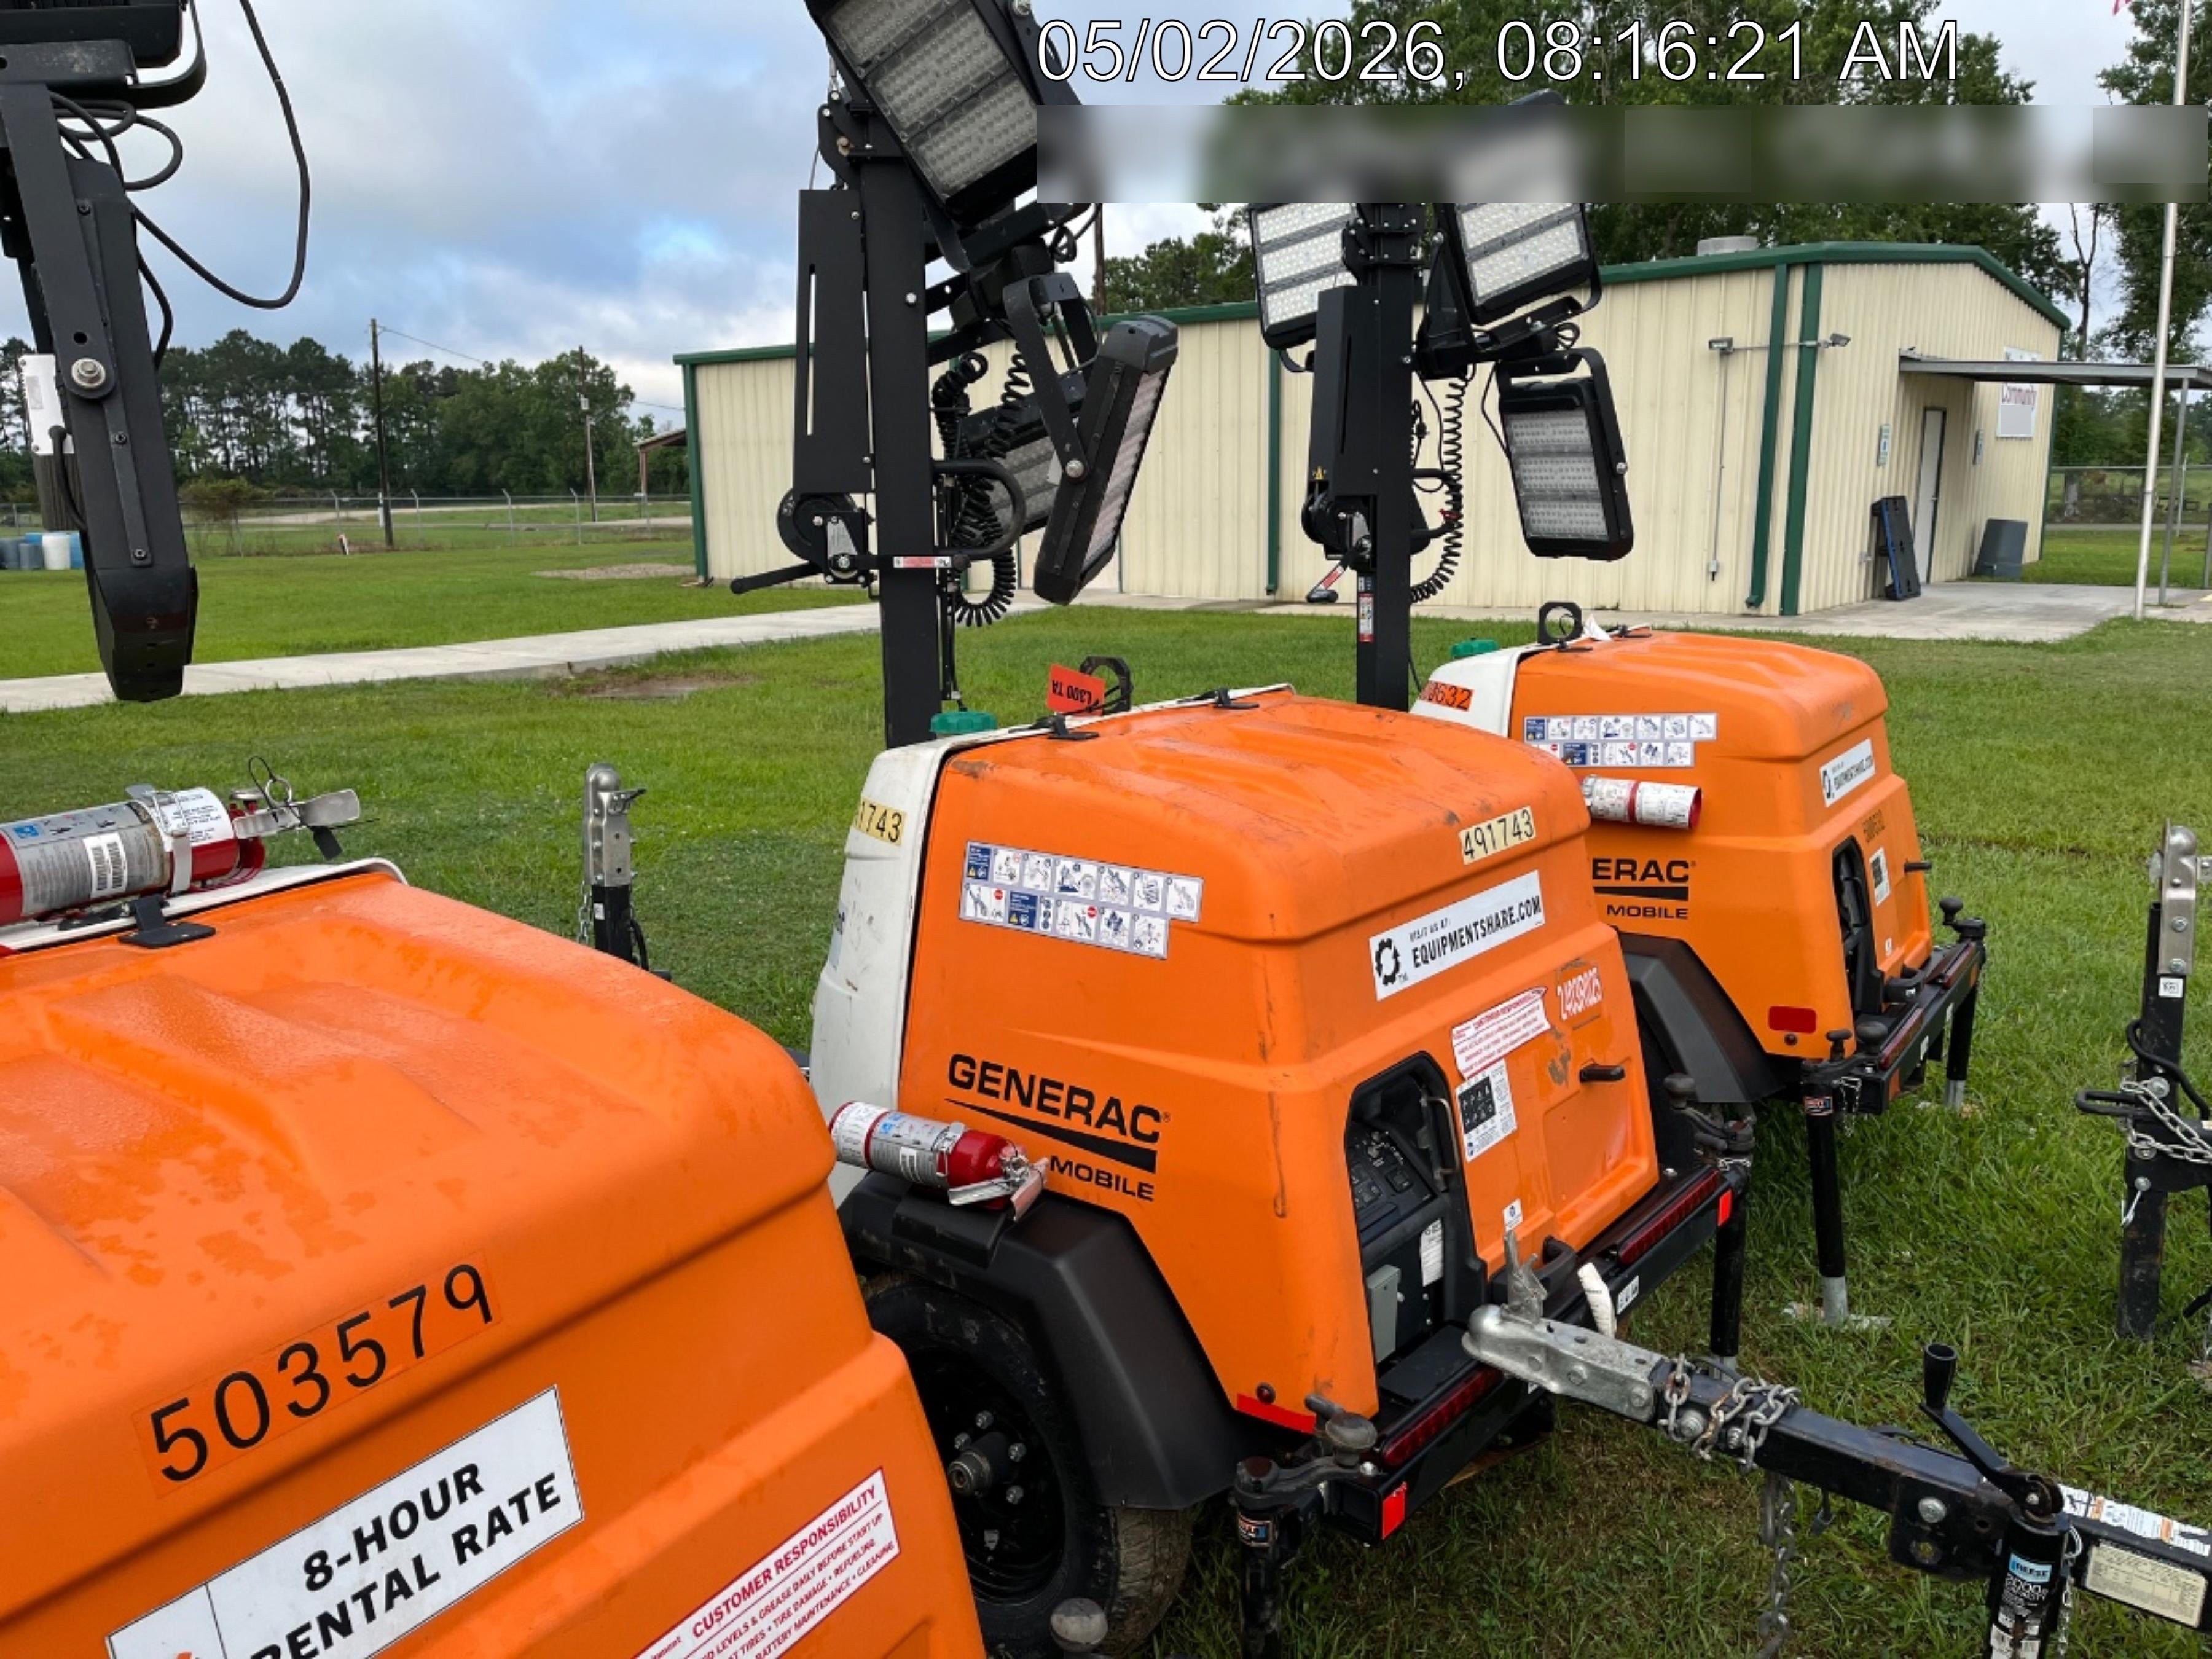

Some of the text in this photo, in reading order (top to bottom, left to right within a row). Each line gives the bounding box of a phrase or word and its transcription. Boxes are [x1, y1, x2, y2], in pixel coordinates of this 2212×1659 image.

[855, 801, 902, 842] 1743
[1463, 809, 1534, 860] 491743
[1593, 858, 1689, 884] ERAC
[1607, 904, 1689, 920] MOBILE
[1411, 895, 1542, 968] EQUIPMENTSHARE.COM
[948, 1053, 1161, 1144] GENERAC
[1049, 1155, 1155, 1202] MOBILE
[150, 1263, 493, 1483] 503579
[303, 1463, 485, 1592] 8-HOUR
[450, 1472, 562, 1565] RATE
[692, 1484, 876, 1638] CUSTOMER RESPONSIBILITY
[716, 1512, 884, 1654] LEVELS & GREASE DAILY BEFORE START UP
[740, 1629, 766, 1655] TIRES
[772, 1607, 793, 1628] TIRE
[793, 1577, 828, 1612] DAMAGE
[833, 1538, 876, 1578] REFUELING
[755, 1540, 895, 1659] BATTERY MAINTENANCE CLEANING
